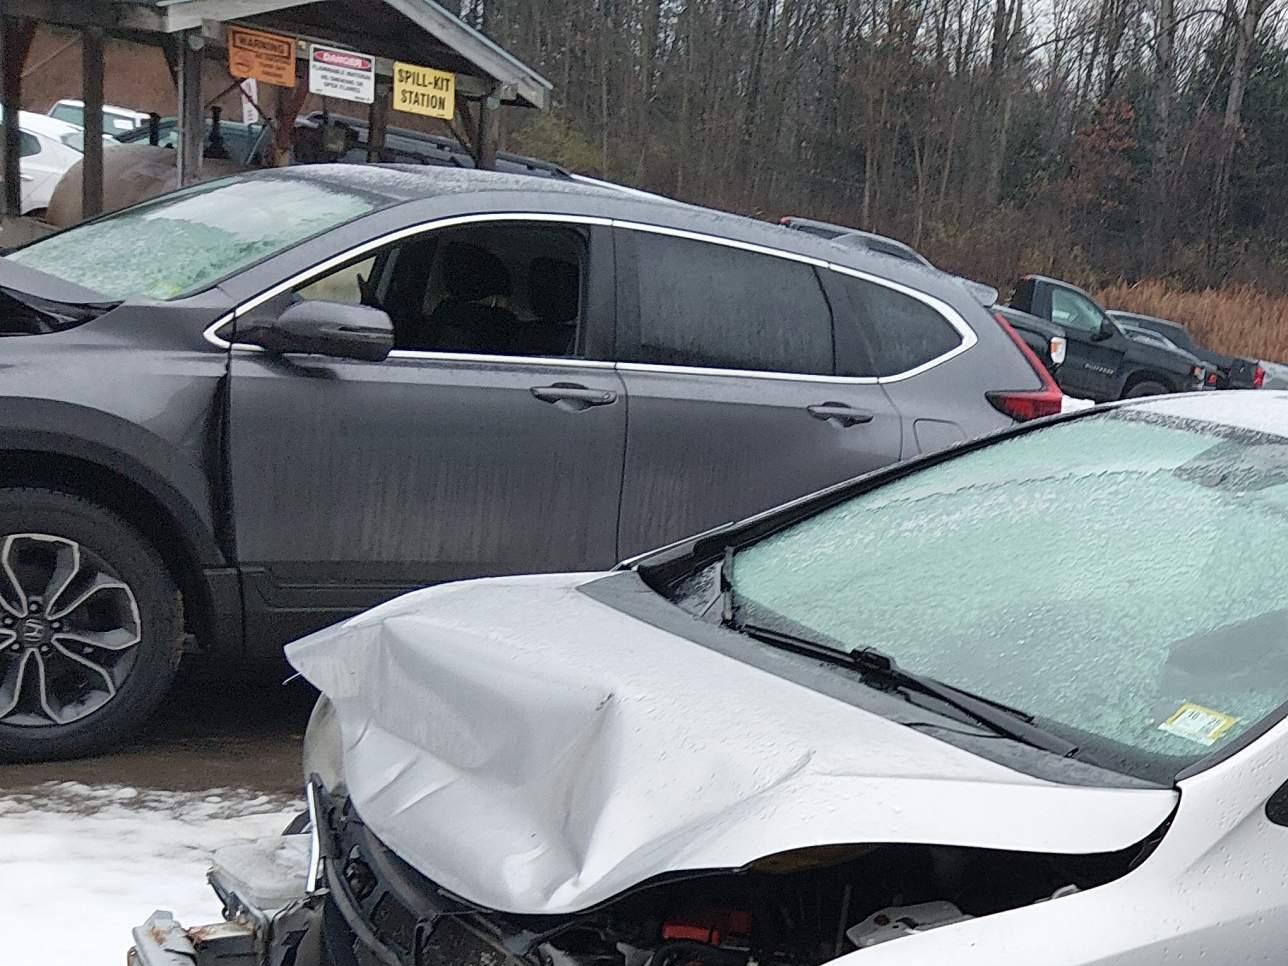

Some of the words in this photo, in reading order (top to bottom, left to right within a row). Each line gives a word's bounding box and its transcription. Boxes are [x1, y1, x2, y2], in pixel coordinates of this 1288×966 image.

[322, 51, 363, 68] DANGER
[398, 68, 451, 92] SPILL-KIT
[400, 88, 446, 111] STATION
